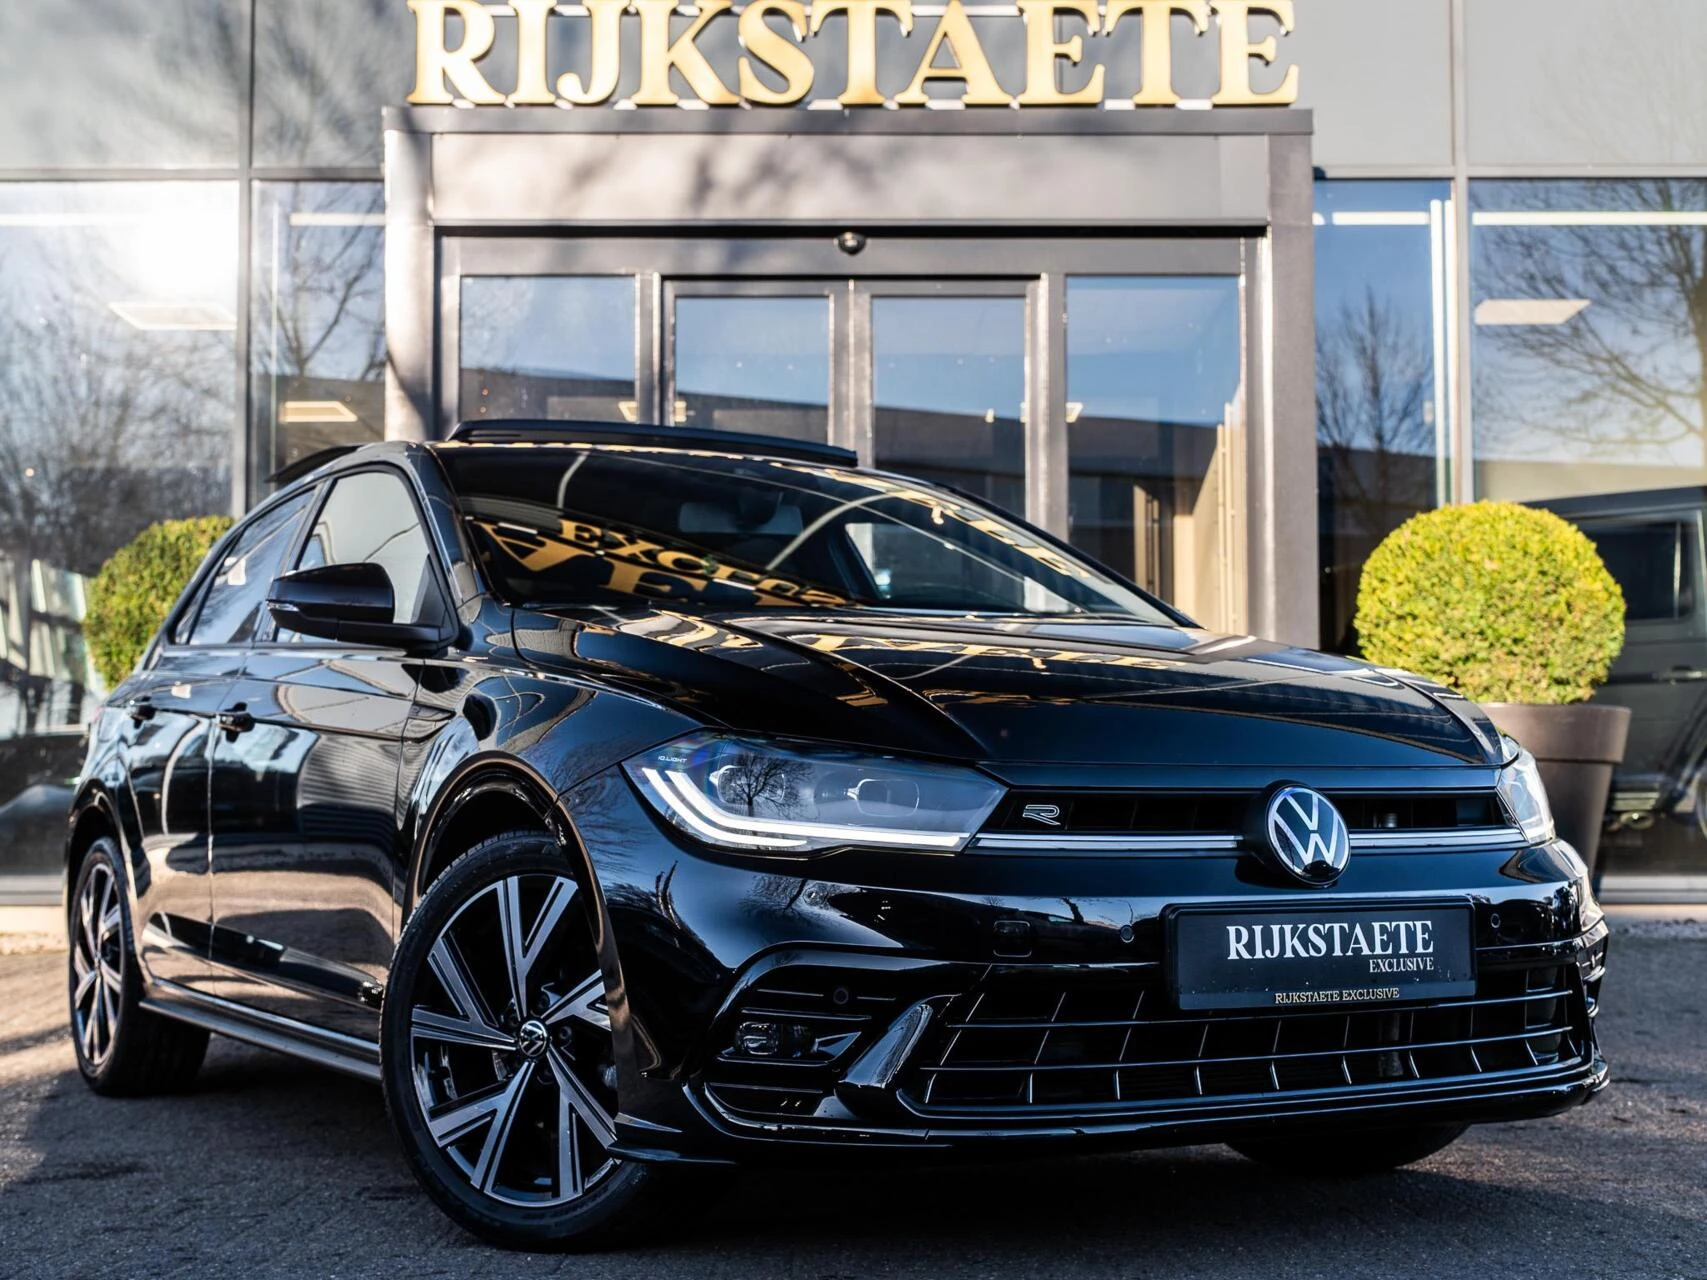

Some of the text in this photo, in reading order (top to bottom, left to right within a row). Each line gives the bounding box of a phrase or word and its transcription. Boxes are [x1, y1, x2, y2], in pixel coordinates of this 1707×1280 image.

[406, 0, 1300, 106] RIJKSTAETE
[1226, 920, 1434, 960] RIJKSTAETE
[1369, 956, 1434, 973] EXCLUSIVE
[1274, 987, 1400, 1004] RIJKSTAETE EXCLUSIVE
